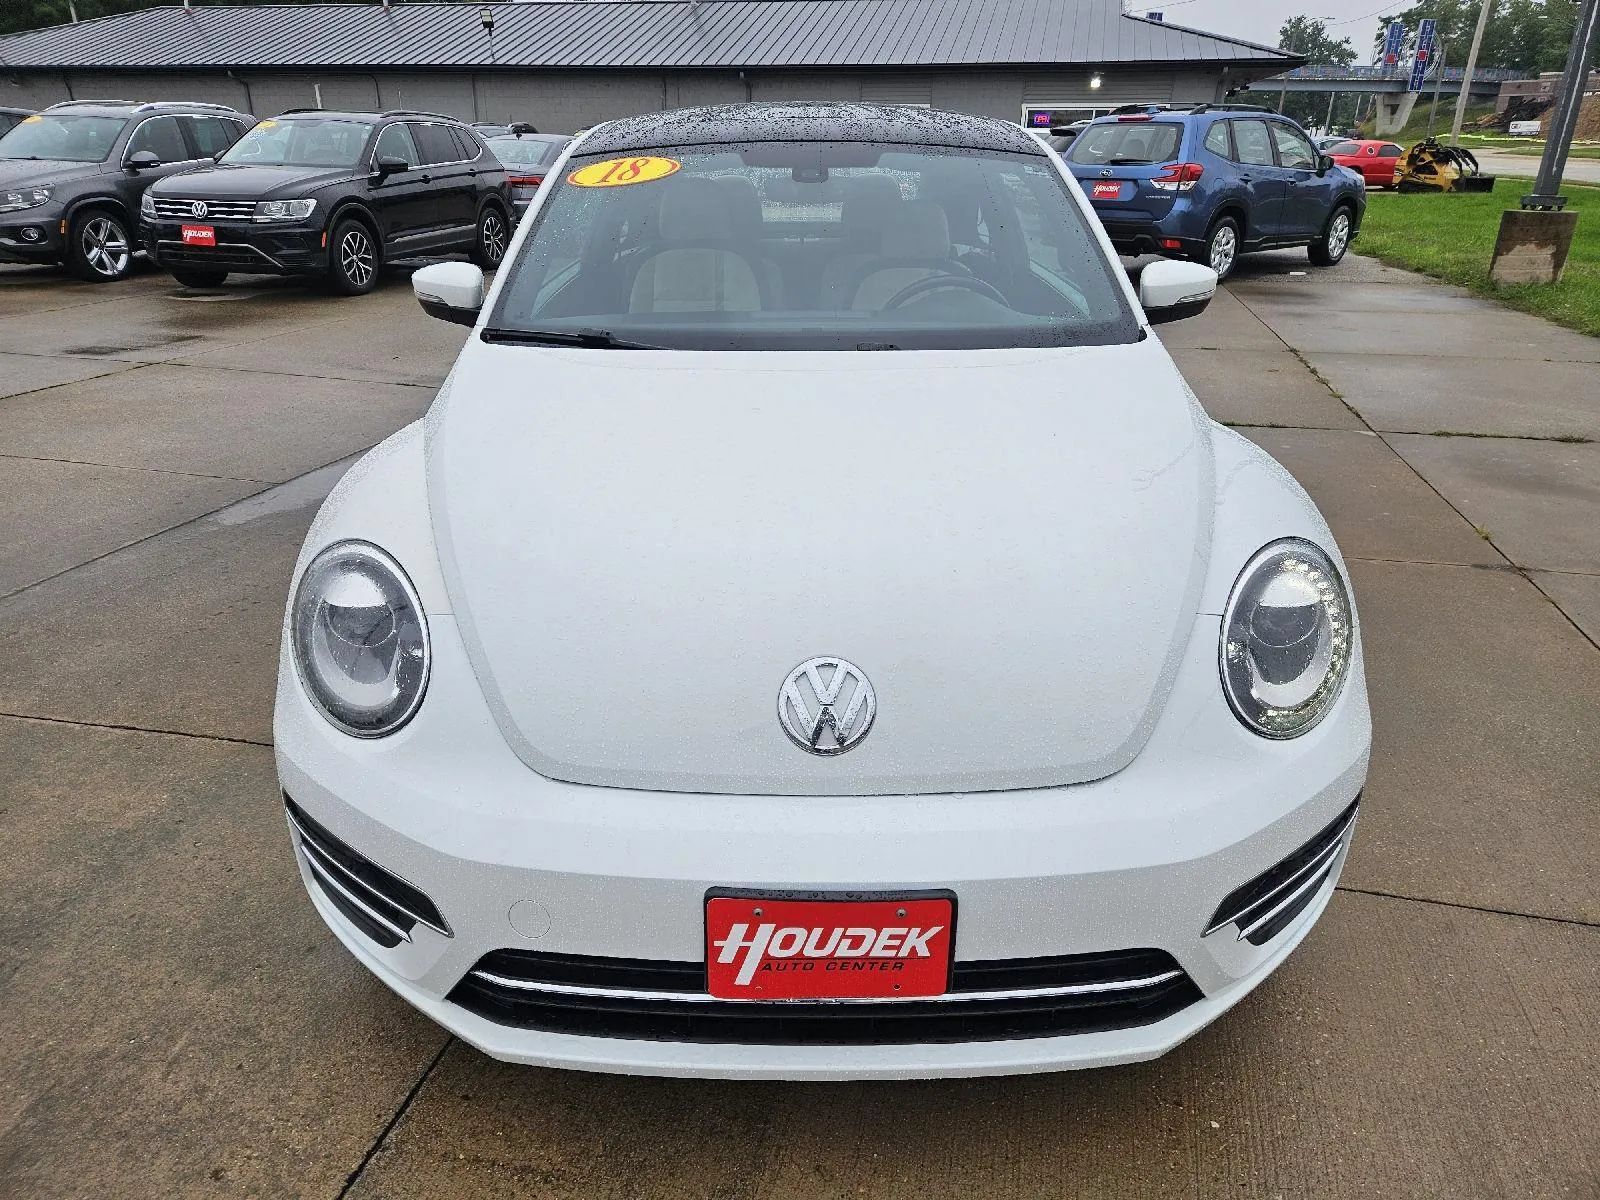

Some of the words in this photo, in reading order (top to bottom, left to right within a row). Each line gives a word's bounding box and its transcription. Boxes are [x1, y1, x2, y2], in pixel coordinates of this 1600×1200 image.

[599, 158, 650, 183] 18
[183, 229, 214, 242] HOUDEK
[713, 923, 945, 986] HOUDEK
[761, 961, 815, 972] AUTO
[825, 961, 905, 972] CENTER
